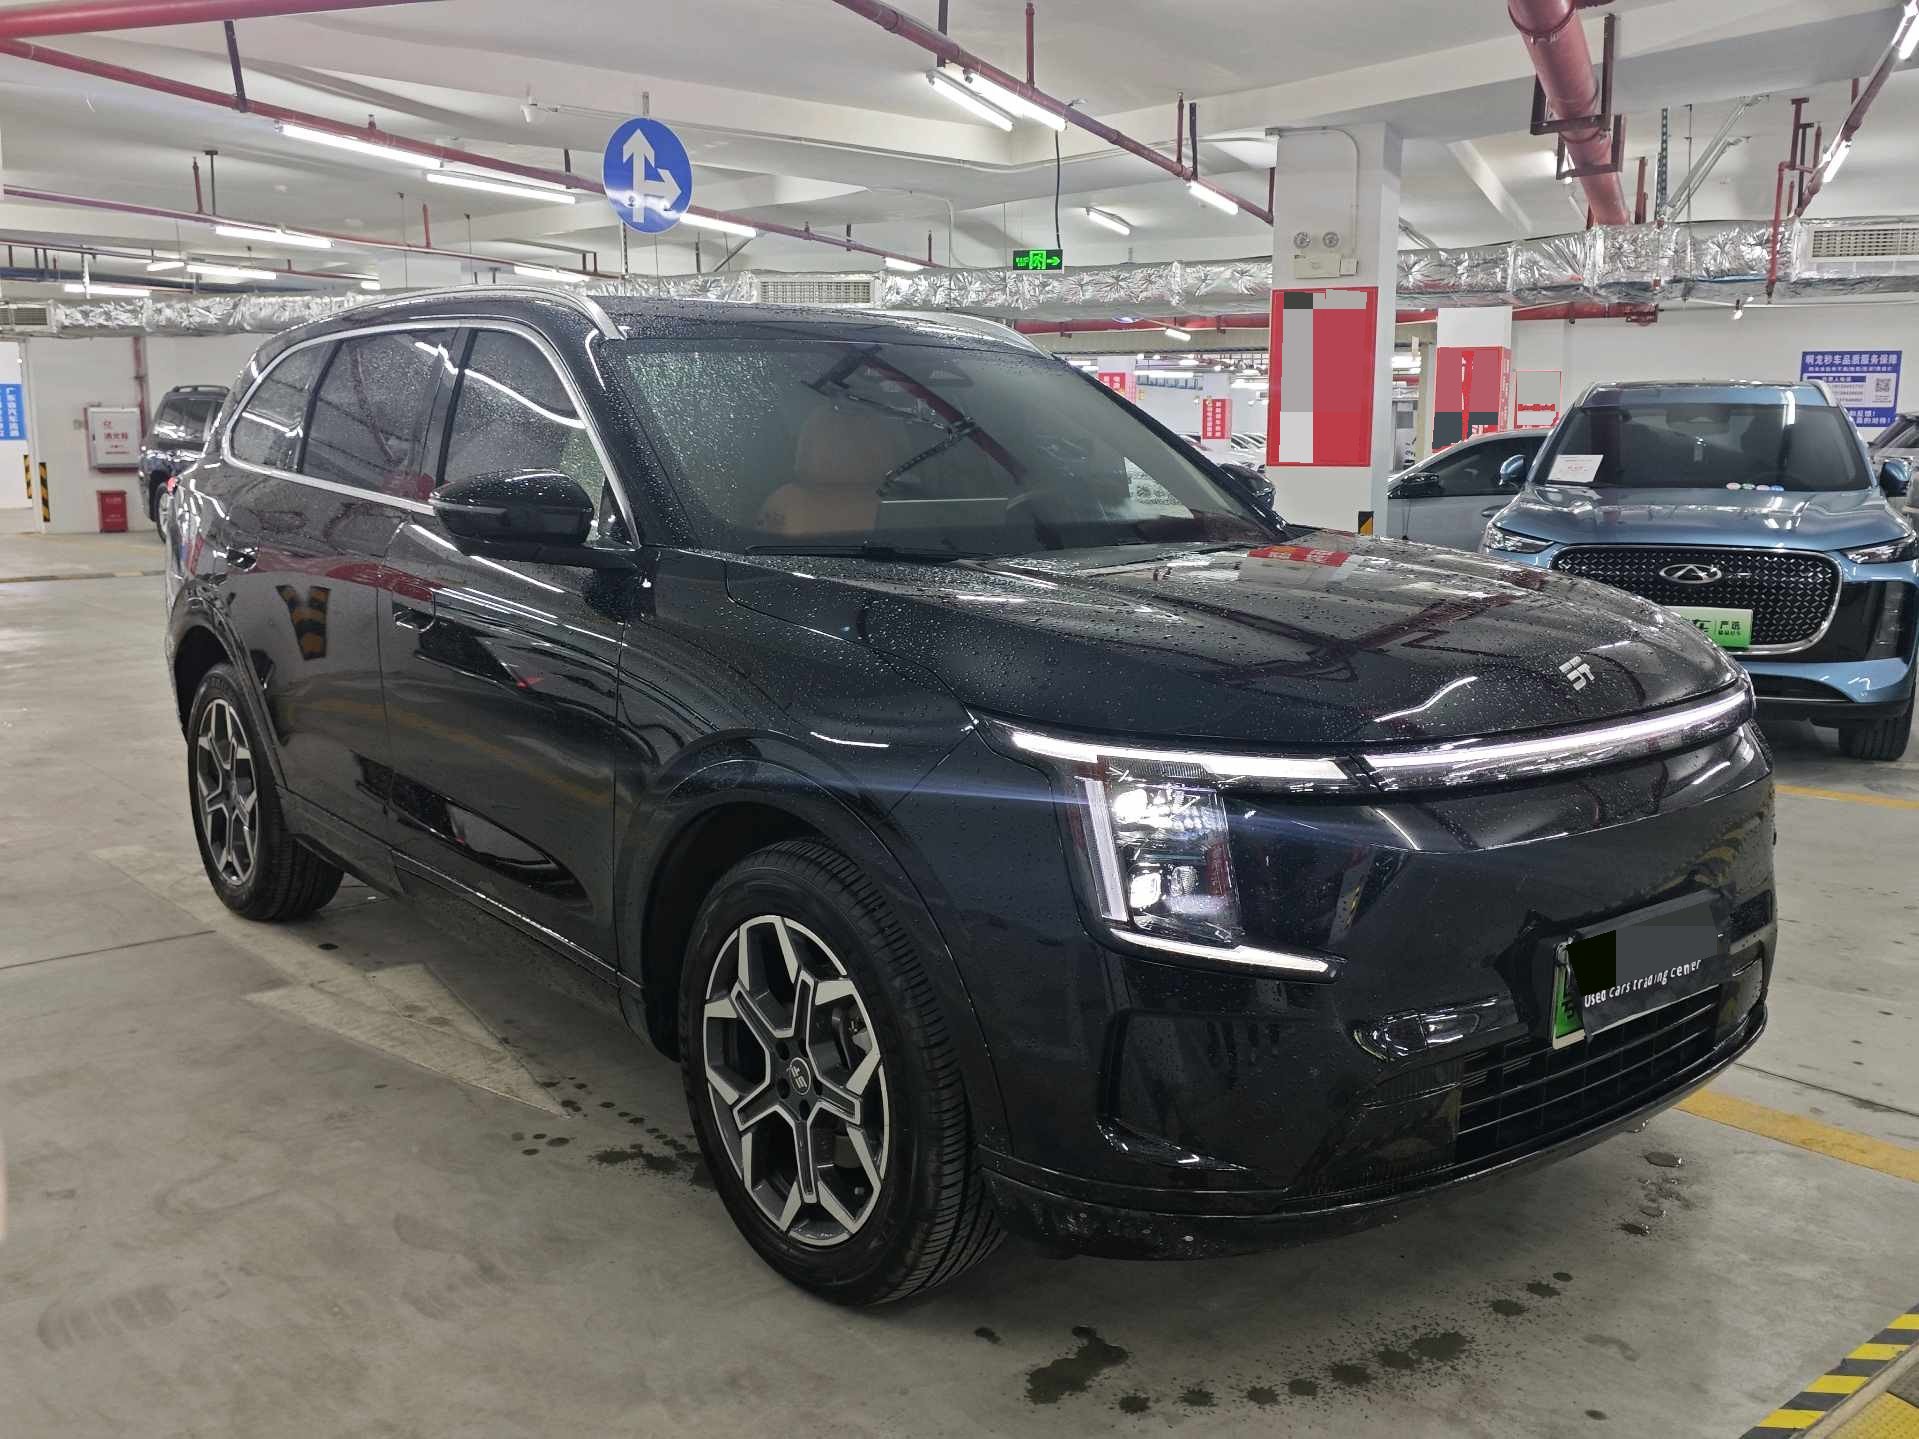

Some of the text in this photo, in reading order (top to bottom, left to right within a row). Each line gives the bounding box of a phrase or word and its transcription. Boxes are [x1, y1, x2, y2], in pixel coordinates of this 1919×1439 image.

[1584, 989, 1607, 1009] Used
[1609, 982, 1631, 999] cars
[1633, 969, 1669, 991] trading
[1670, 959, 1702, 978] cener
